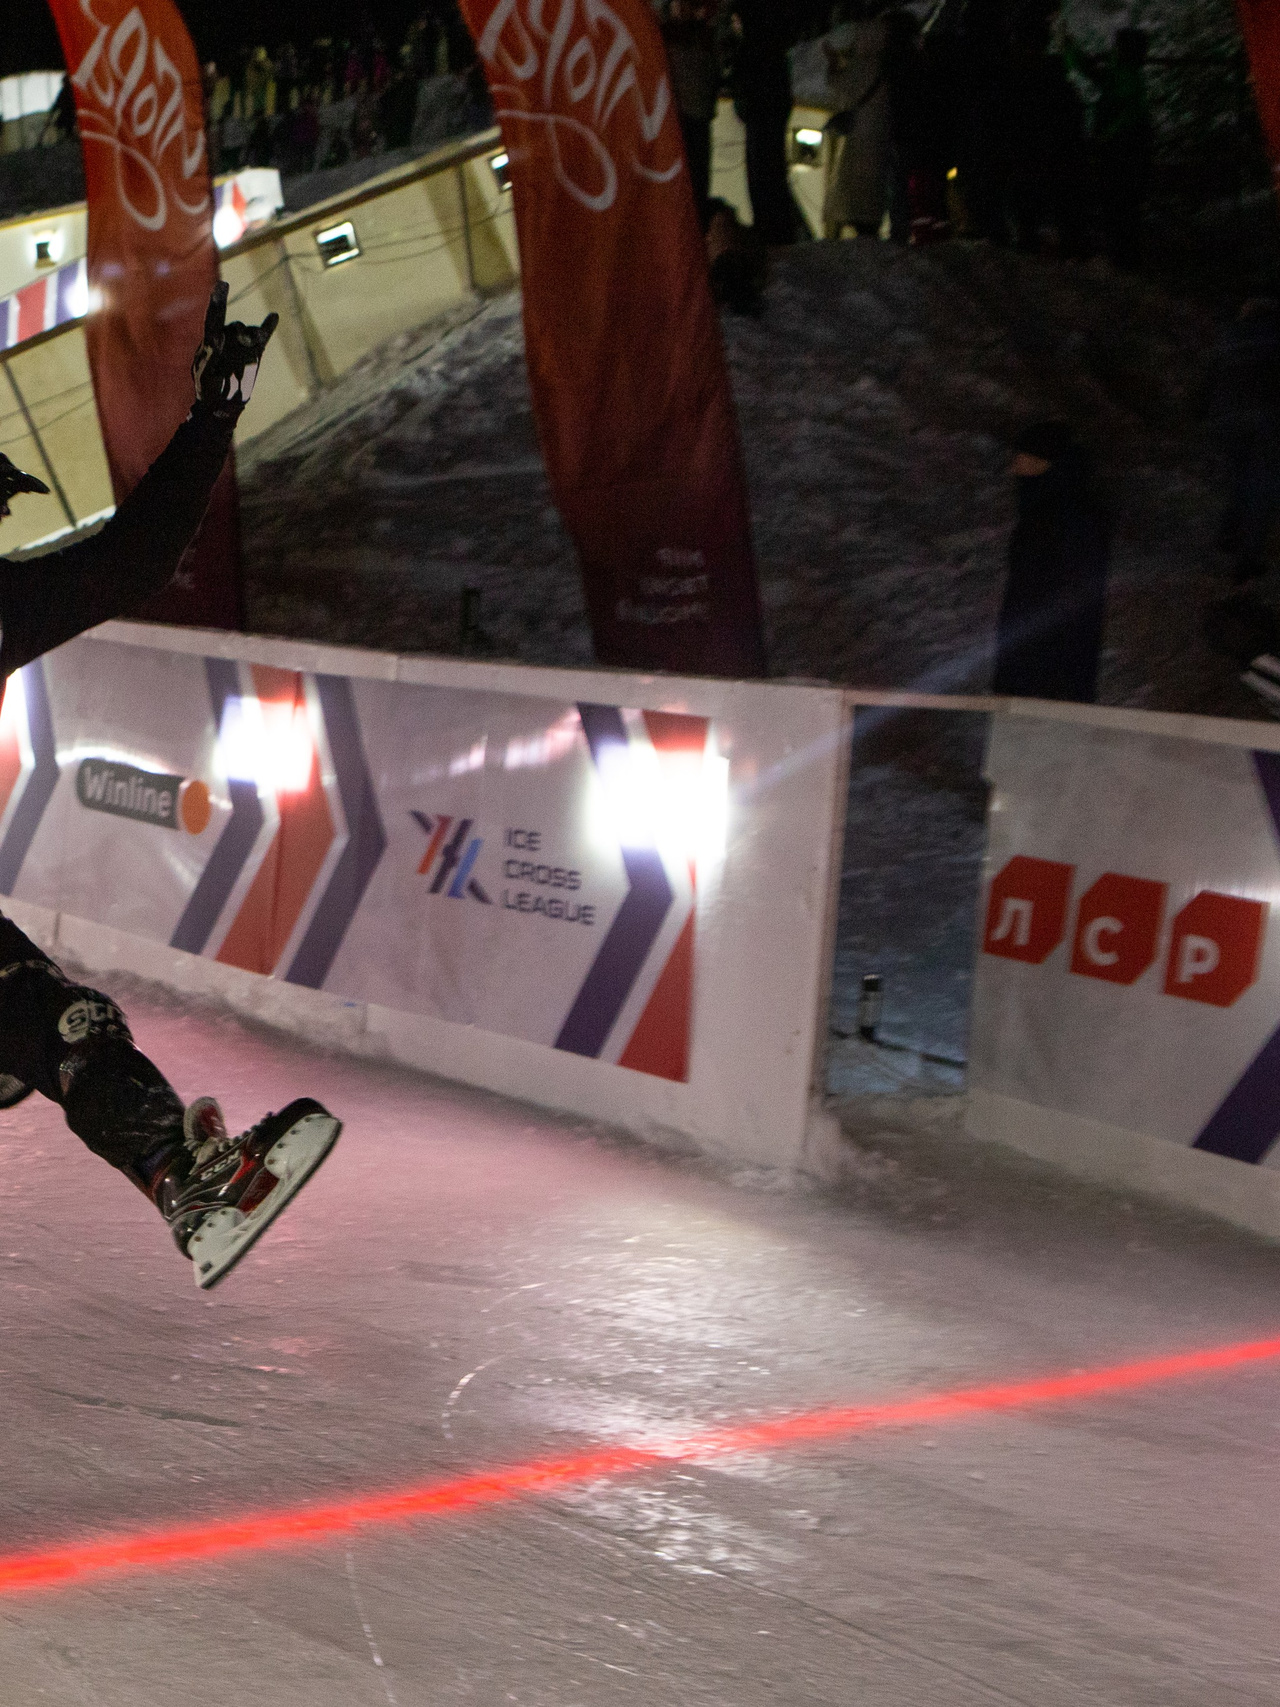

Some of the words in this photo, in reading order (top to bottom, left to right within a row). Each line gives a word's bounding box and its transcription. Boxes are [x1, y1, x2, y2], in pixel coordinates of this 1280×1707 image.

[83, 766, 170, 818] Winline
[505, 826, 542, 852] ICE
[502, 858, 582, 891] CROSS
[502, 888, 596, 926] LEAGUE
[988, 894, 1225, 986] ЛСР
